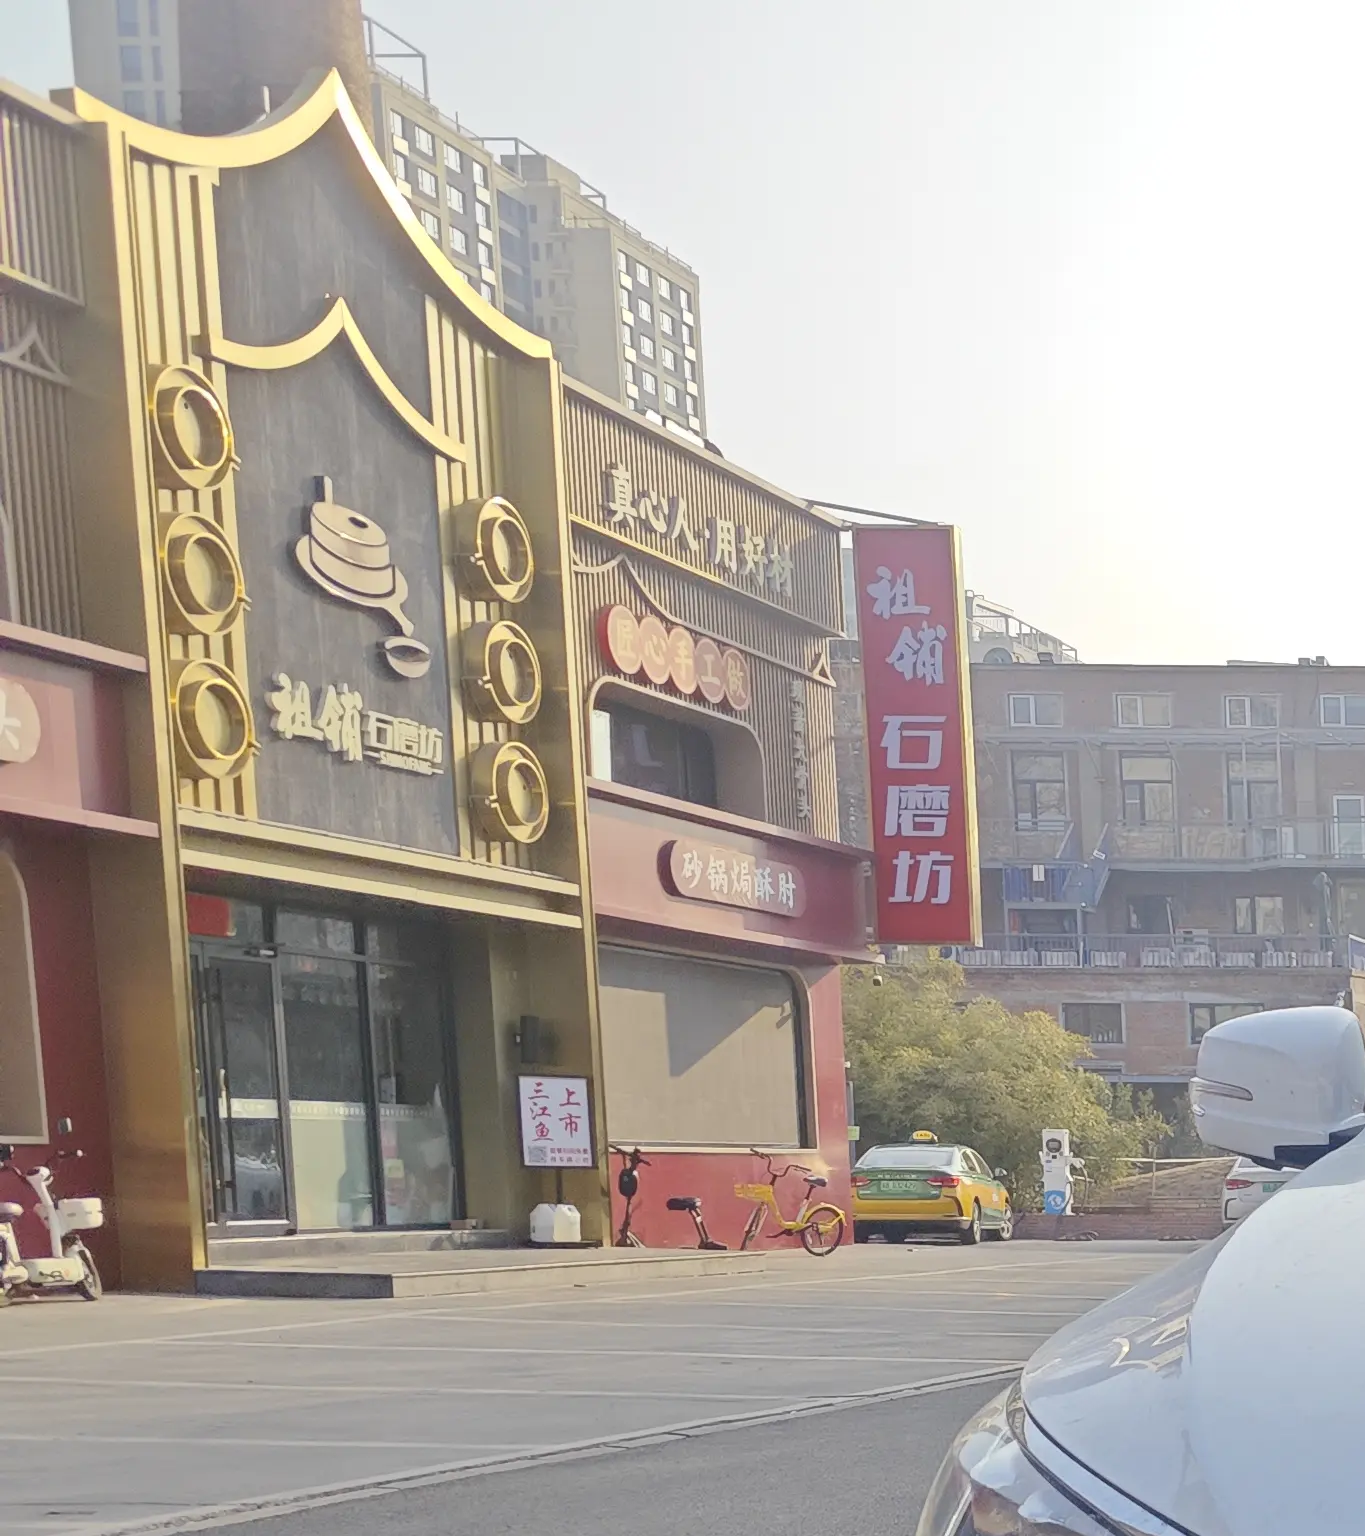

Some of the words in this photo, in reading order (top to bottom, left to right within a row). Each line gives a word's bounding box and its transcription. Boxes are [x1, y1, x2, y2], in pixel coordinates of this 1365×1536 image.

[616, 618, 747, 698] 匠心手工做
[681, 850, 796, 909] 砂锅焗酥肘
[528, 1081, 554, 1141] 三江鱼
[558, 1087, 581, 1138] 上市
